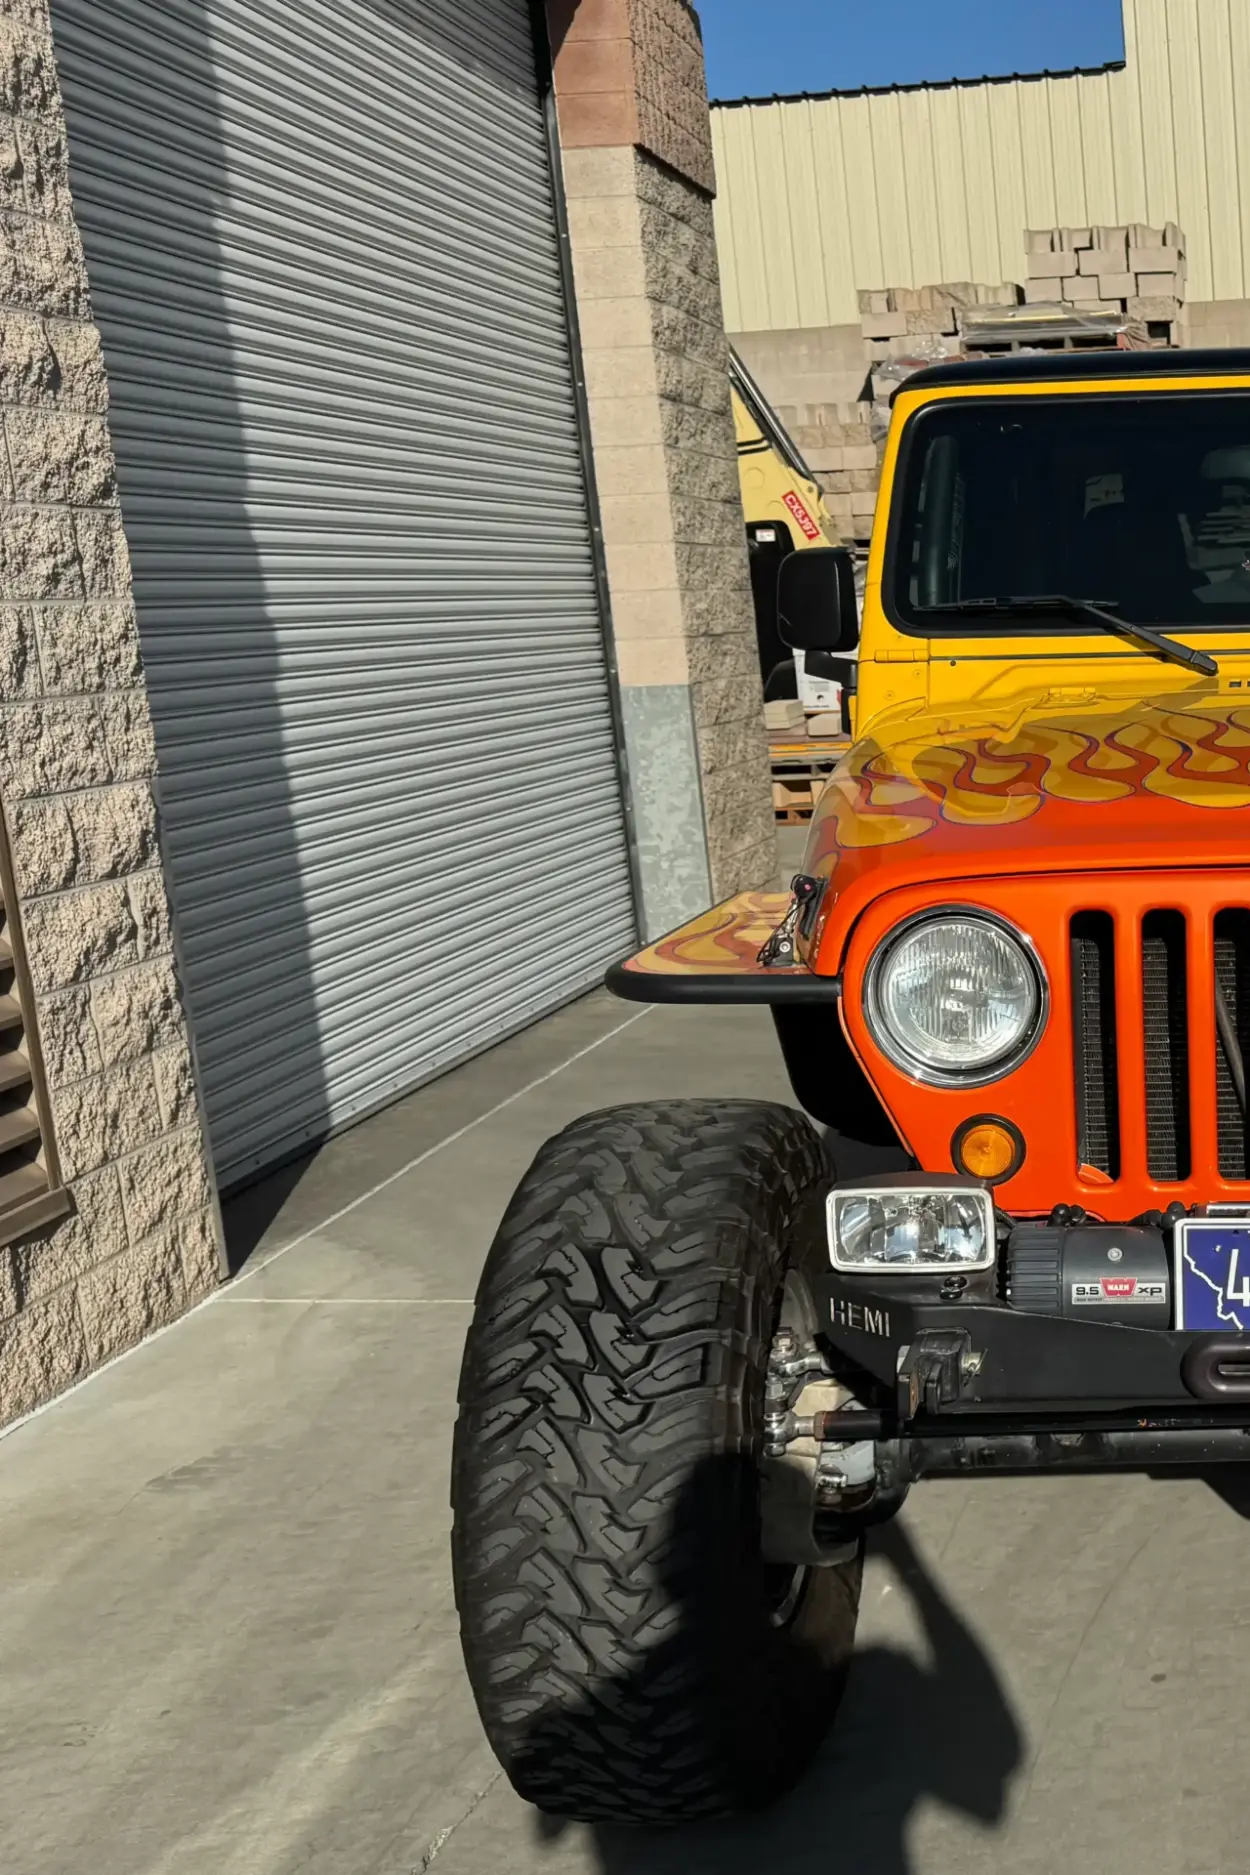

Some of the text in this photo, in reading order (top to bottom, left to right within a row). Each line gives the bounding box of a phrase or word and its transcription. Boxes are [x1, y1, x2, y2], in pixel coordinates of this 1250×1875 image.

[1075, 1286, 1100, 1296] 9.5
[1107, 1283, 1130, 1292] WARN
[829, 1297, 891, 1338] HEMI
